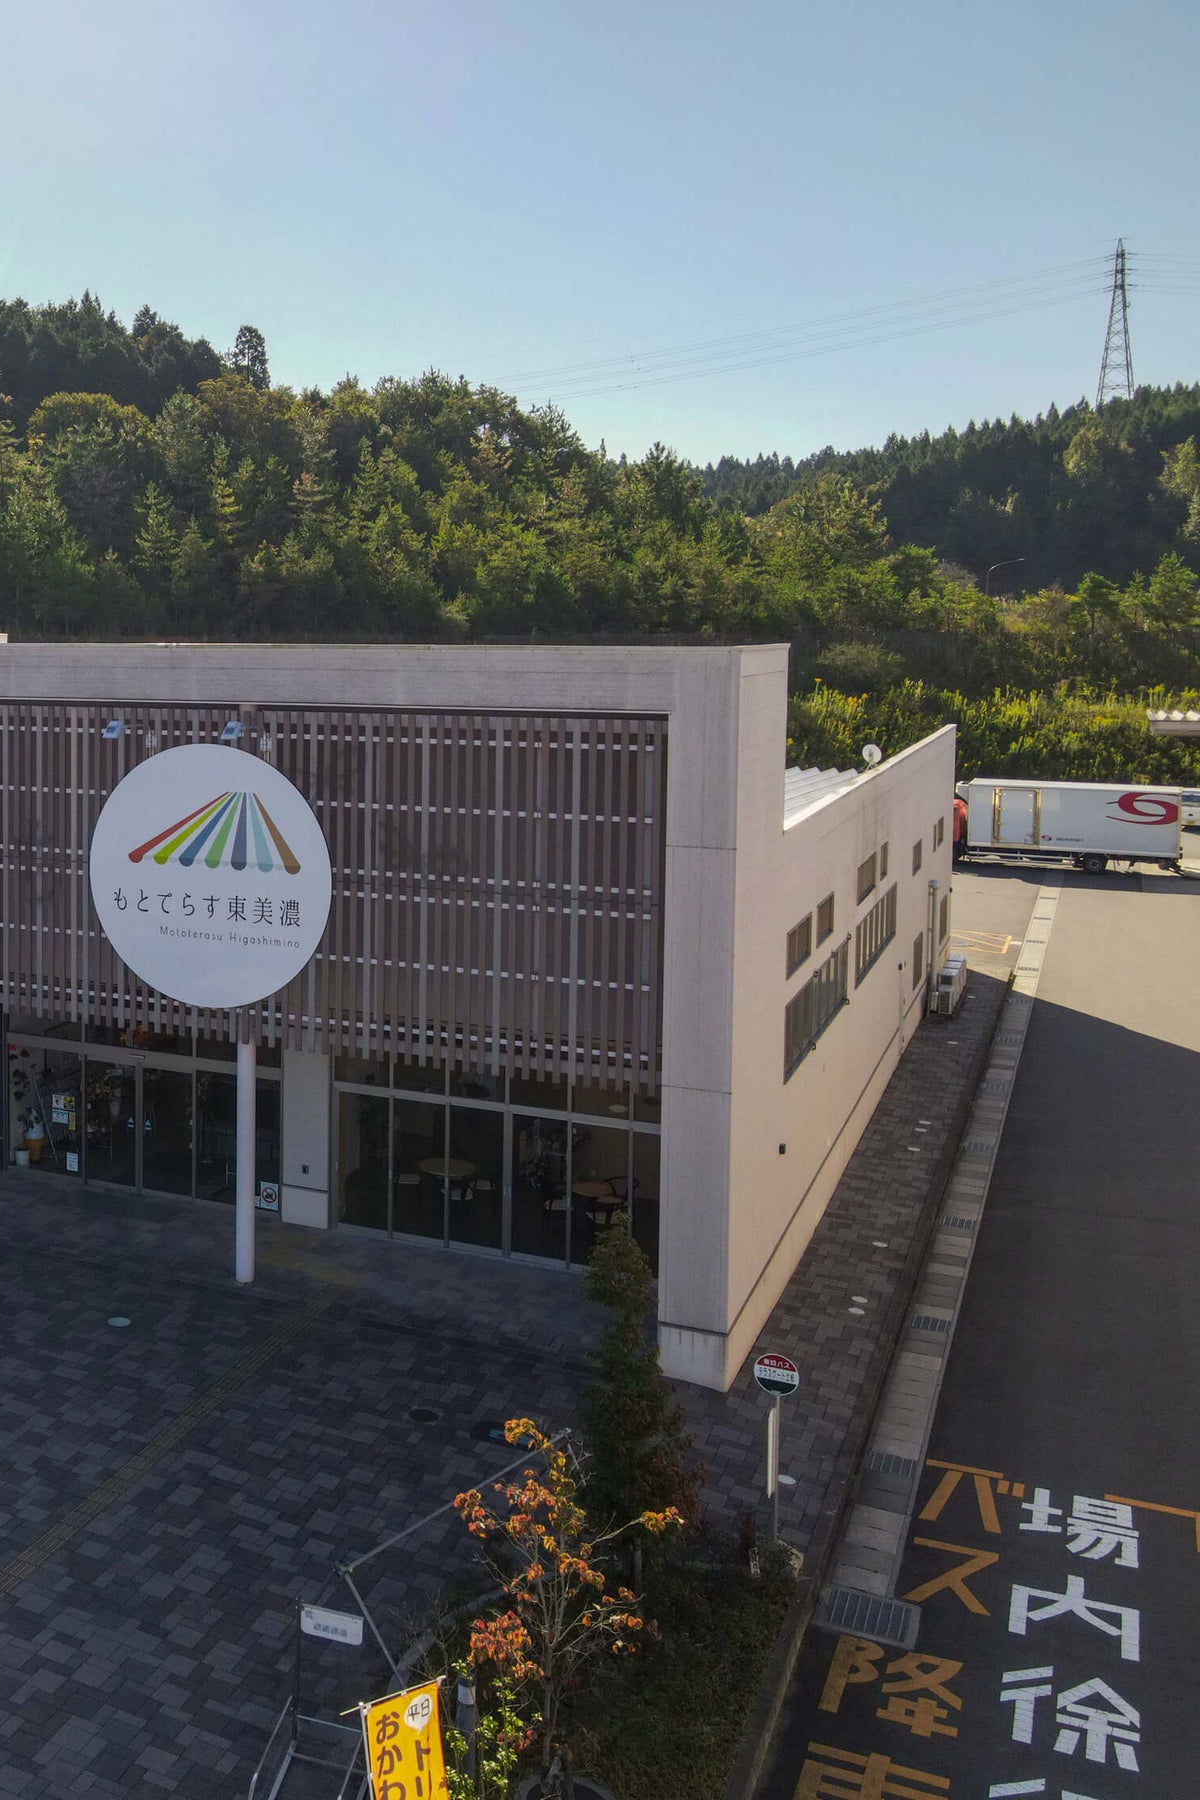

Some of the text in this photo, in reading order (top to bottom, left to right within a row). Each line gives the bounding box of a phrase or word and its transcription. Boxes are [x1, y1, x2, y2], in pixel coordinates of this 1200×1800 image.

[113, 888, 302, 927] もとてらす東美濃
[159, 926, 301, 949] Mototerasu Higashimino
[988, 1486, 1141, 1800] 場内徐
[407, 1698, 430, 1722] 平日
